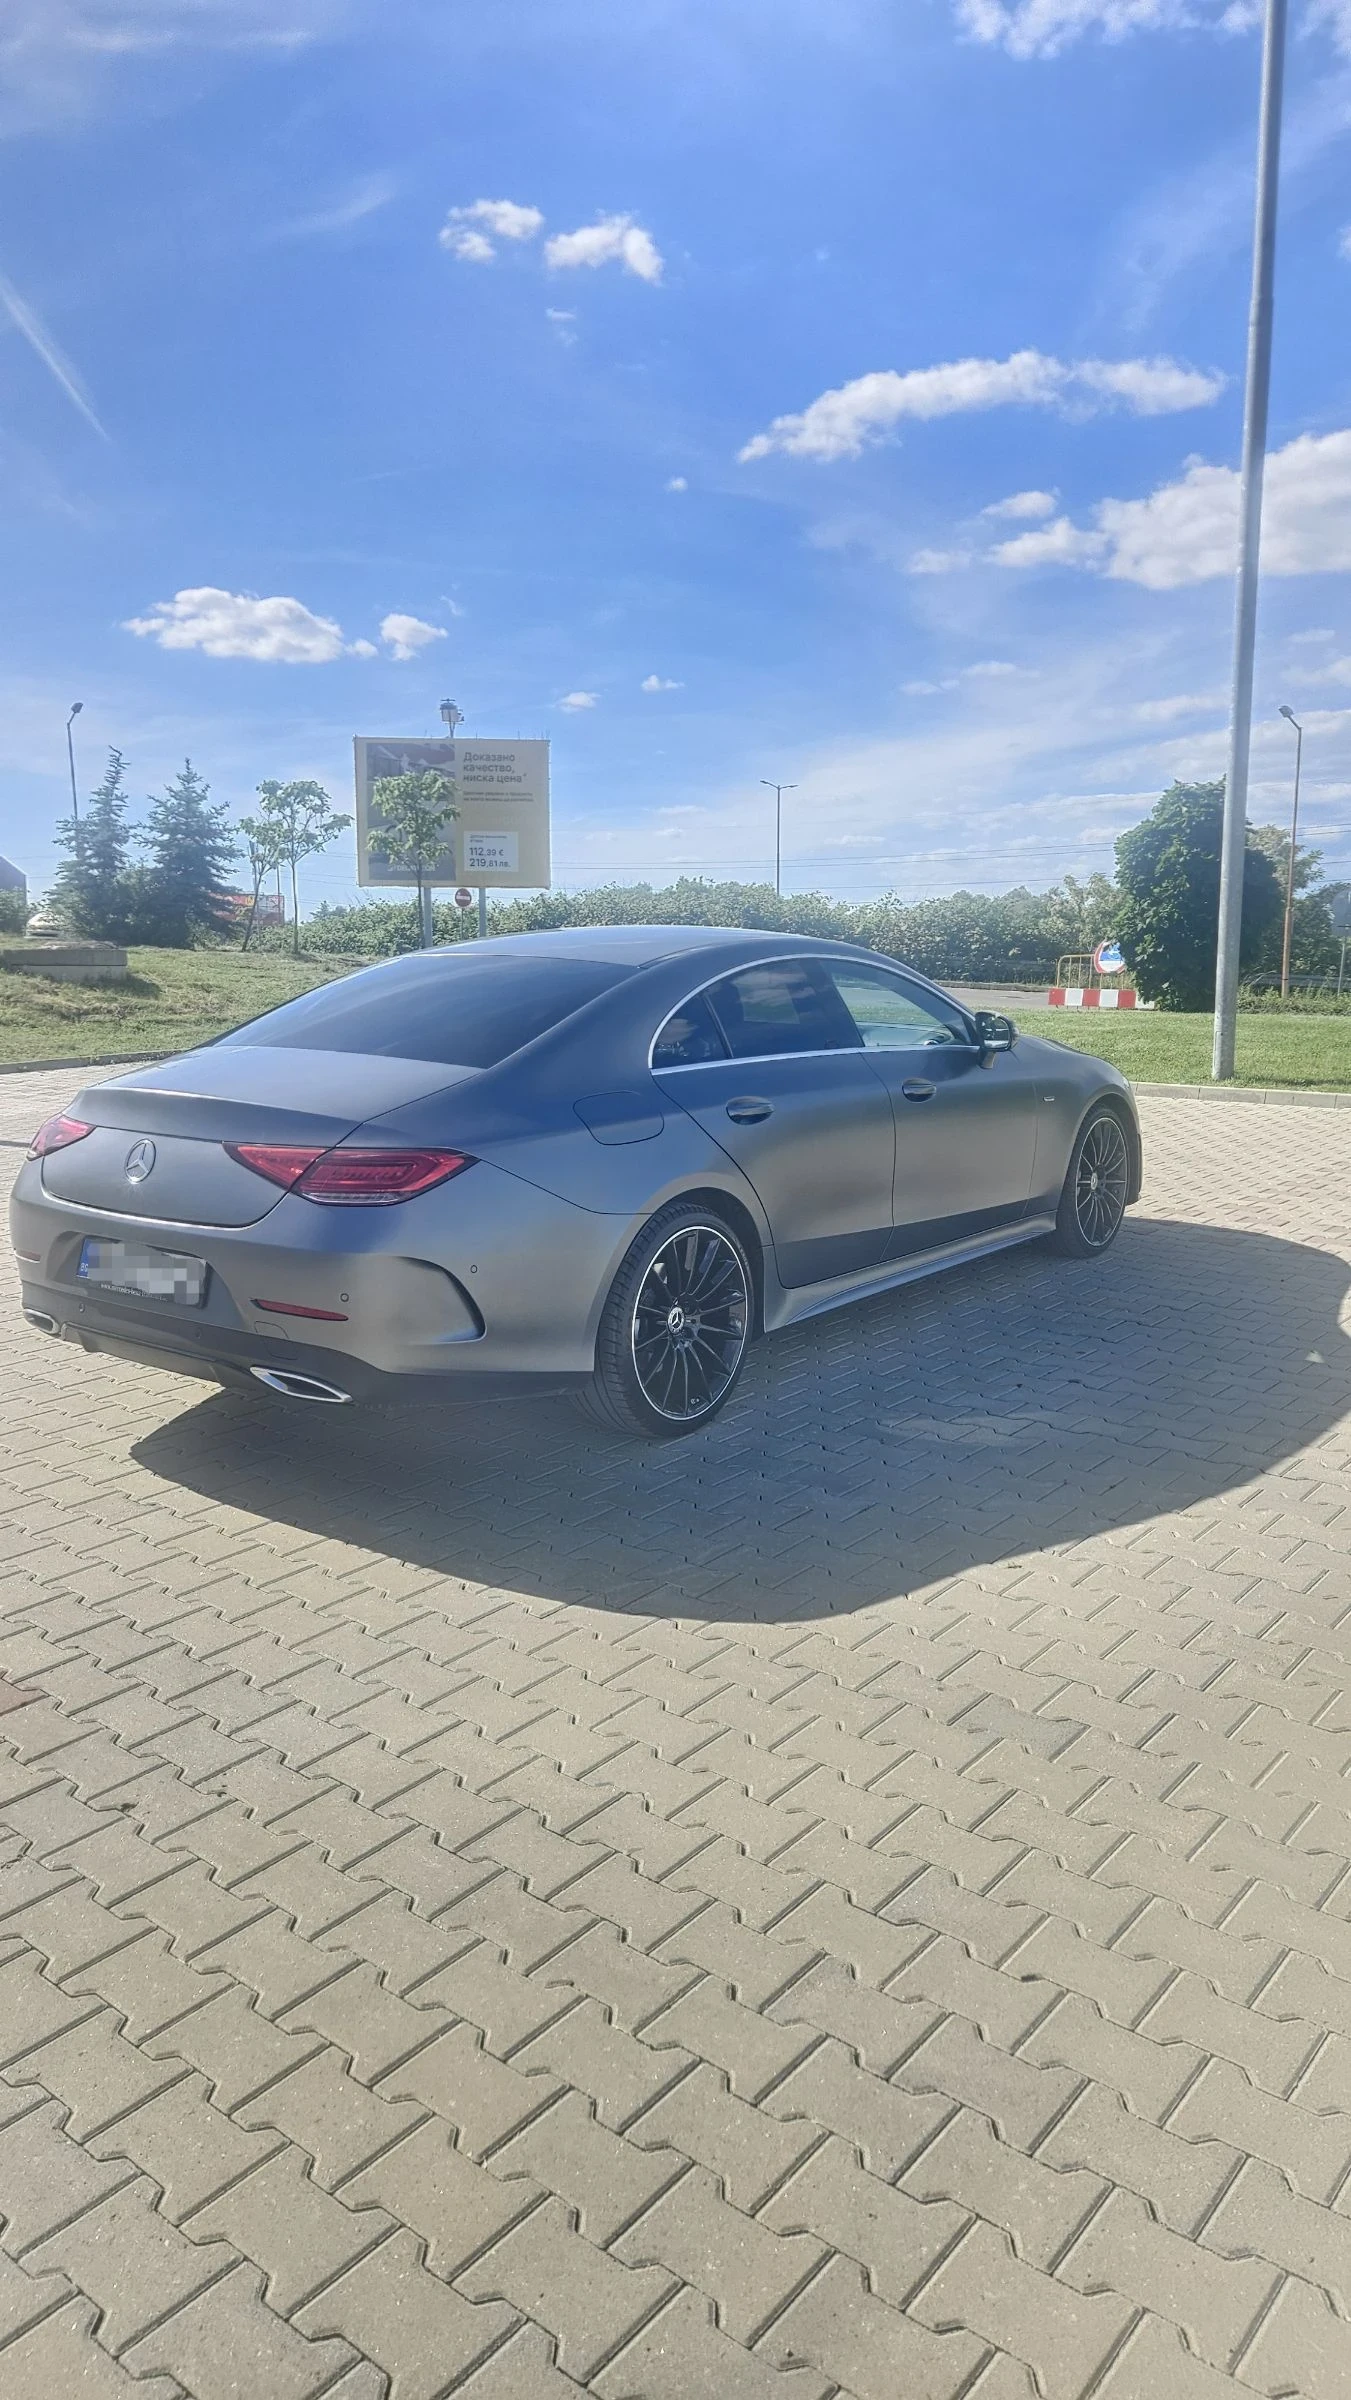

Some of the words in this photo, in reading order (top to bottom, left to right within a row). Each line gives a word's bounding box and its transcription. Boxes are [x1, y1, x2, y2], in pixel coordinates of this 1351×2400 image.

[463, 751, 515, 762] Доказано
[463, 764, 515, 774] качество,
[463, 774, 494, 783] ниска
